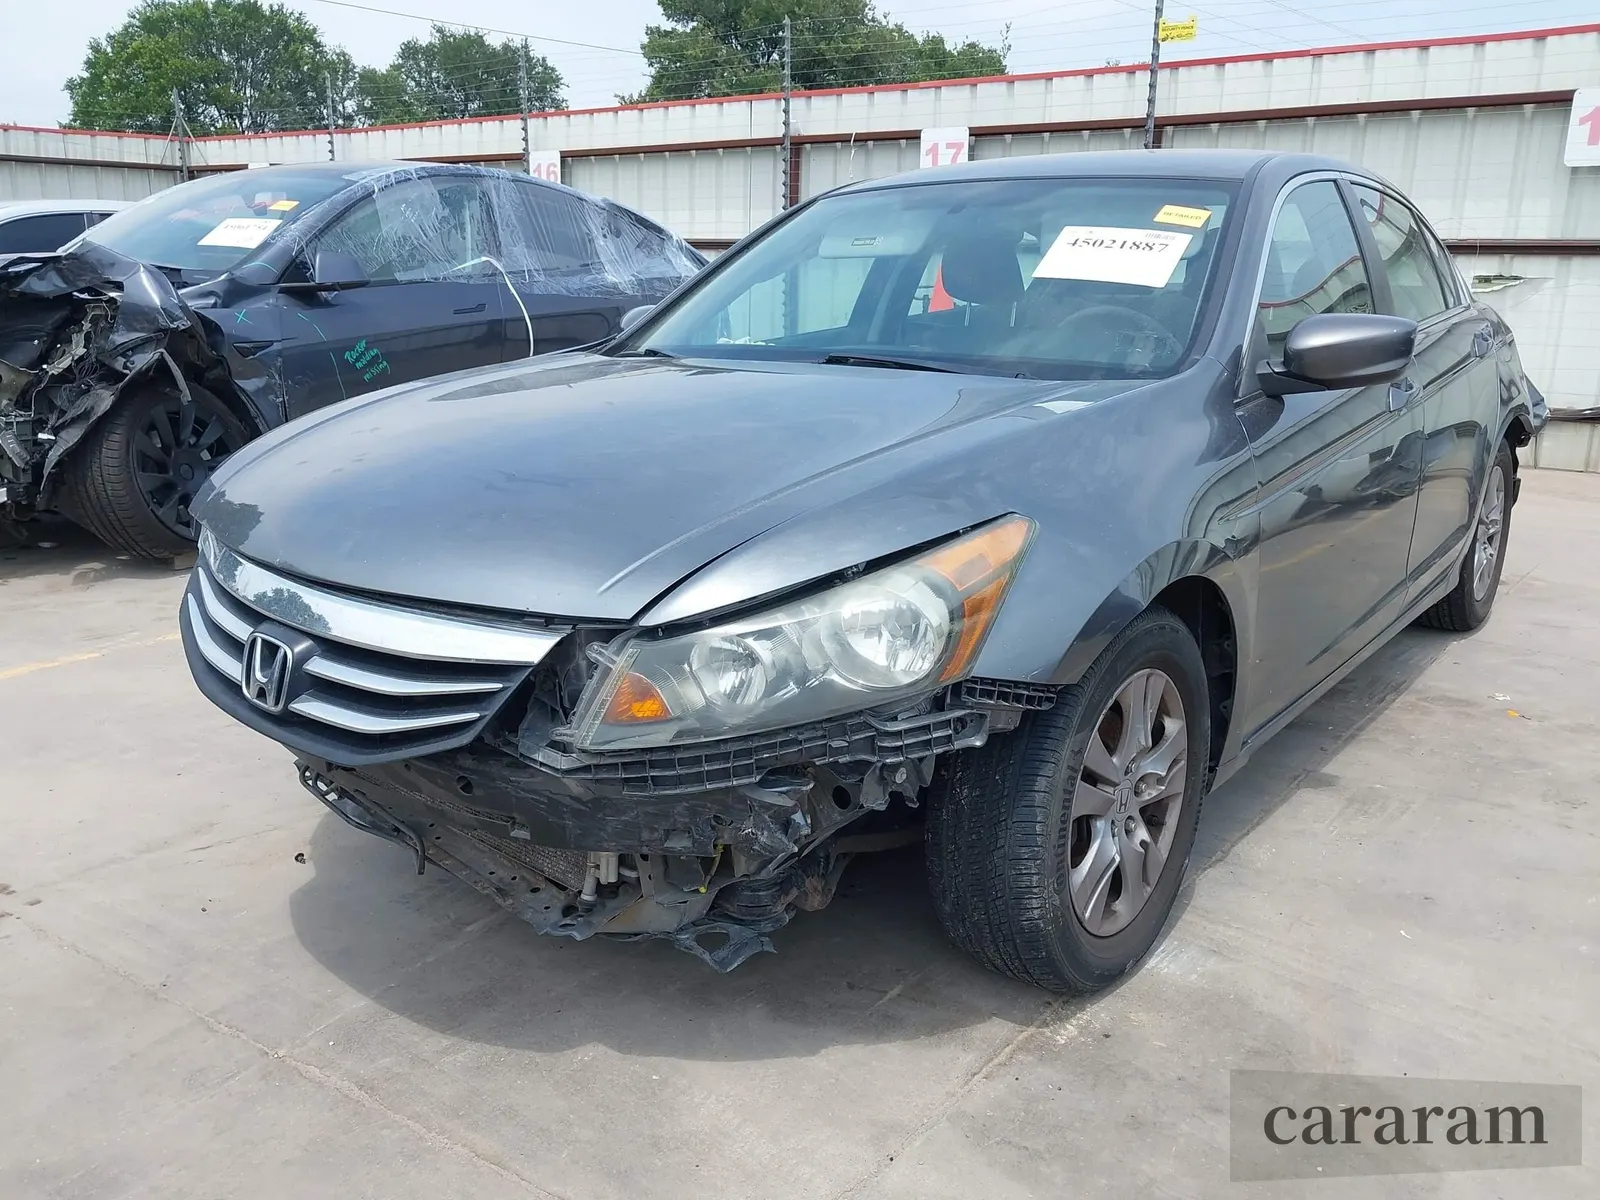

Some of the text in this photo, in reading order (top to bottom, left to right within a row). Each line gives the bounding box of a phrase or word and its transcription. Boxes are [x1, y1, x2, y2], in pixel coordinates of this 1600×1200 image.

[925, 141, 965, 168] 17
[532, 161, 559, 184] 16
[1163, 211, 1202, 220] DETAILED
[1067, 237, 1170, 253] 45021887
[344, 338, 367, 364] Rocker
[363, 359, 391, 383] missing
[1053, 764, 1079, 896] Continental
